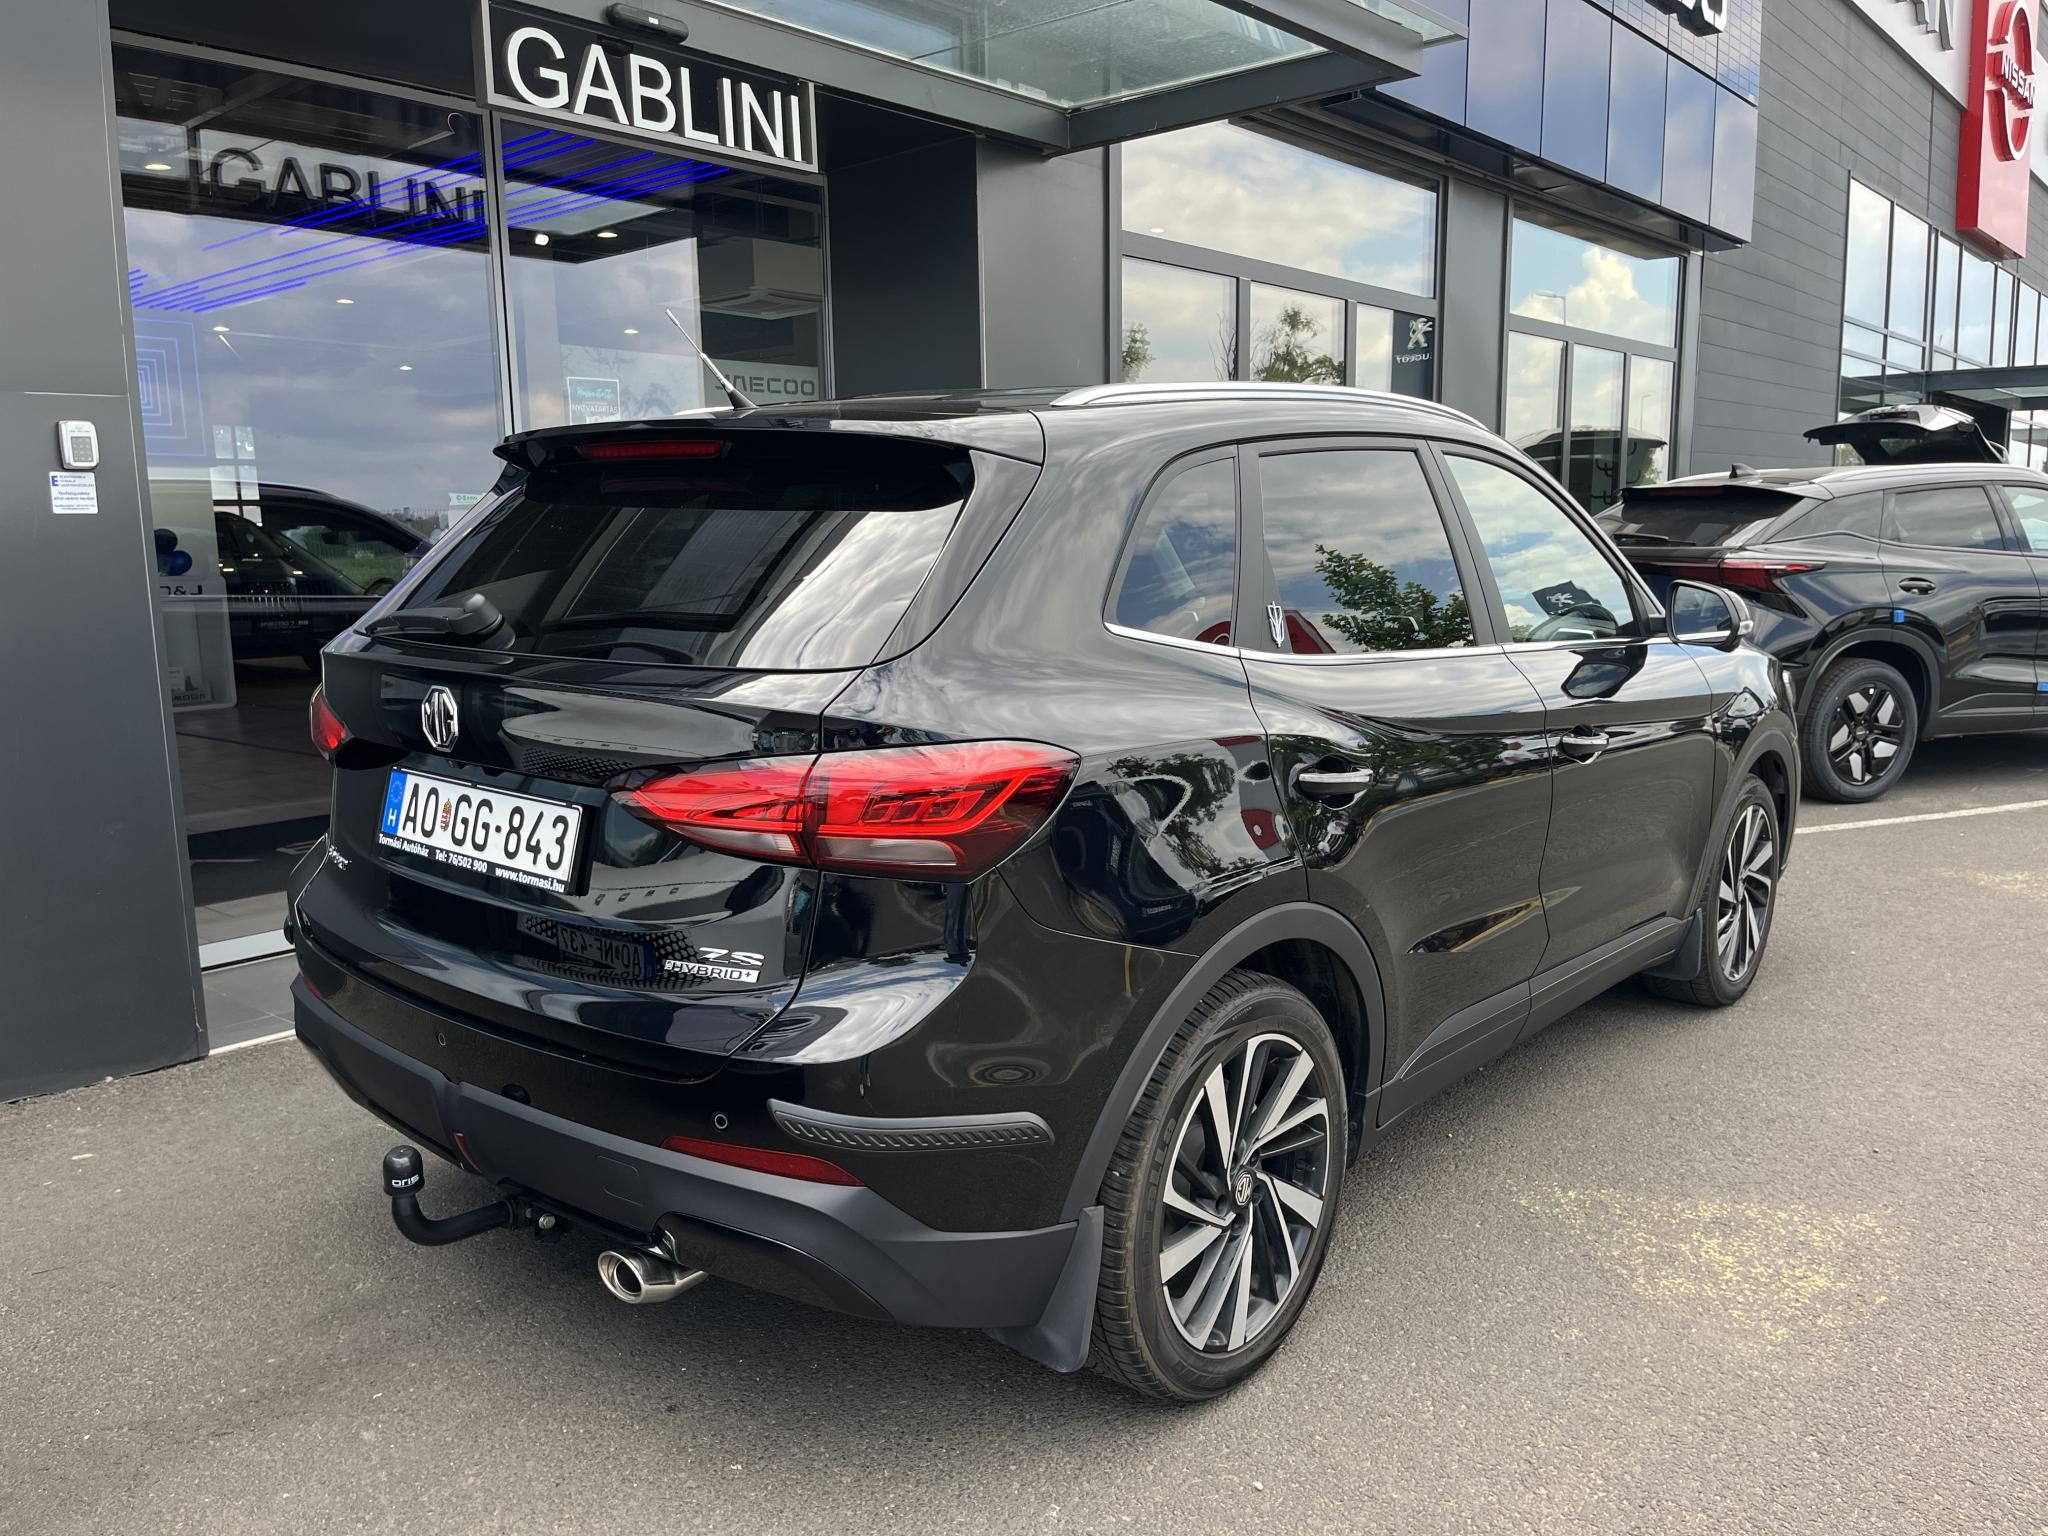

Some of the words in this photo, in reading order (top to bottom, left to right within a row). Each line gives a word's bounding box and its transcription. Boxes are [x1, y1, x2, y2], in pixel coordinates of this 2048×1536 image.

[505, 26, 802, 162] GABLINI
[2002, 50, 2036, 107] NISSAN
[208, 147, 485, 229] GABLINI
[422, 686, 458, 752] MG
[387, 808, 398, 828] H
[379, 833, 403, 849] Tormási
[402, 840, 429, 857] Autóház
[435, 849, 448, 862] Tel:
[448, 852, 472, 869] 76/502
[472, 859, 488, 873] 900
[495, 866, 565, 893] www.tormasi.hu
[699, 947, 765, 966] ZS
